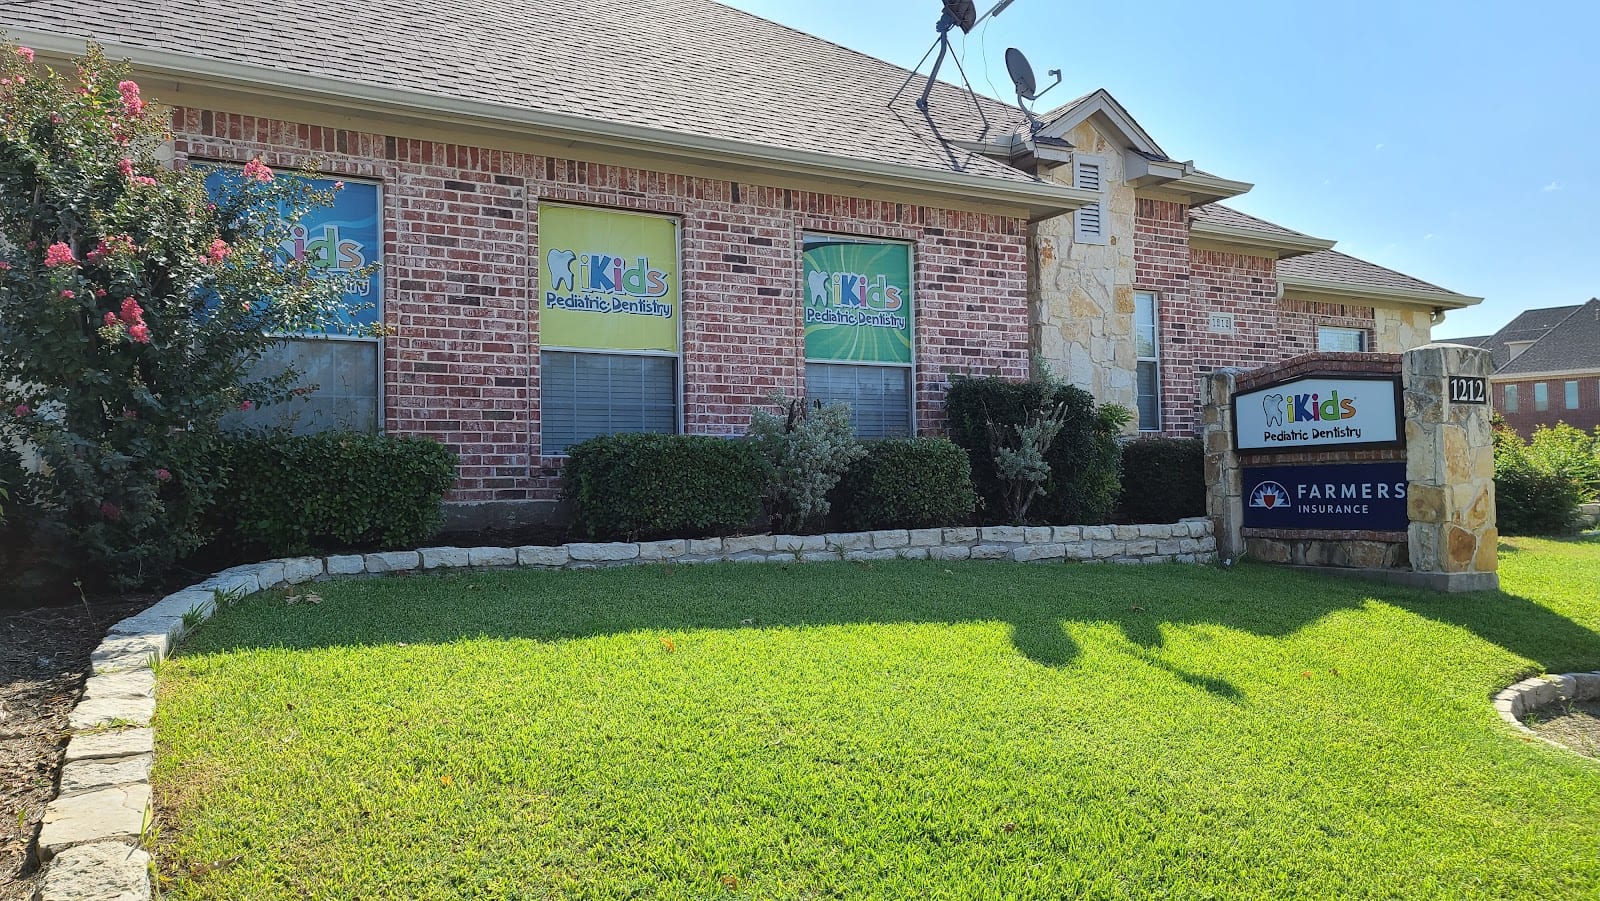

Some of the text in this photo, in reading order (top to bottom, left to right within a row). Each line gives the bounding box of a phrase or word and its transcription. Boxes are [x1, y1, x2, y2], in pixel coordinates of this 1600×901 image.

[580, 254, 666, 295] iKids
[833, 273, 902, 310] iKids
[546, 291, 673, 319] Pediatric Dentistry
[807, 308, 906, 329] Pediatric Dentistry
[1451, 378, 1485, 402] 1212
[1286, 390, 1358, 424] iKids
[1264, 426, 1361, 442] Pediatric Dentistry
[1297, 482, 1406, 500] FARMERS
[1298, 504, 1370, 515] INSURANCE
